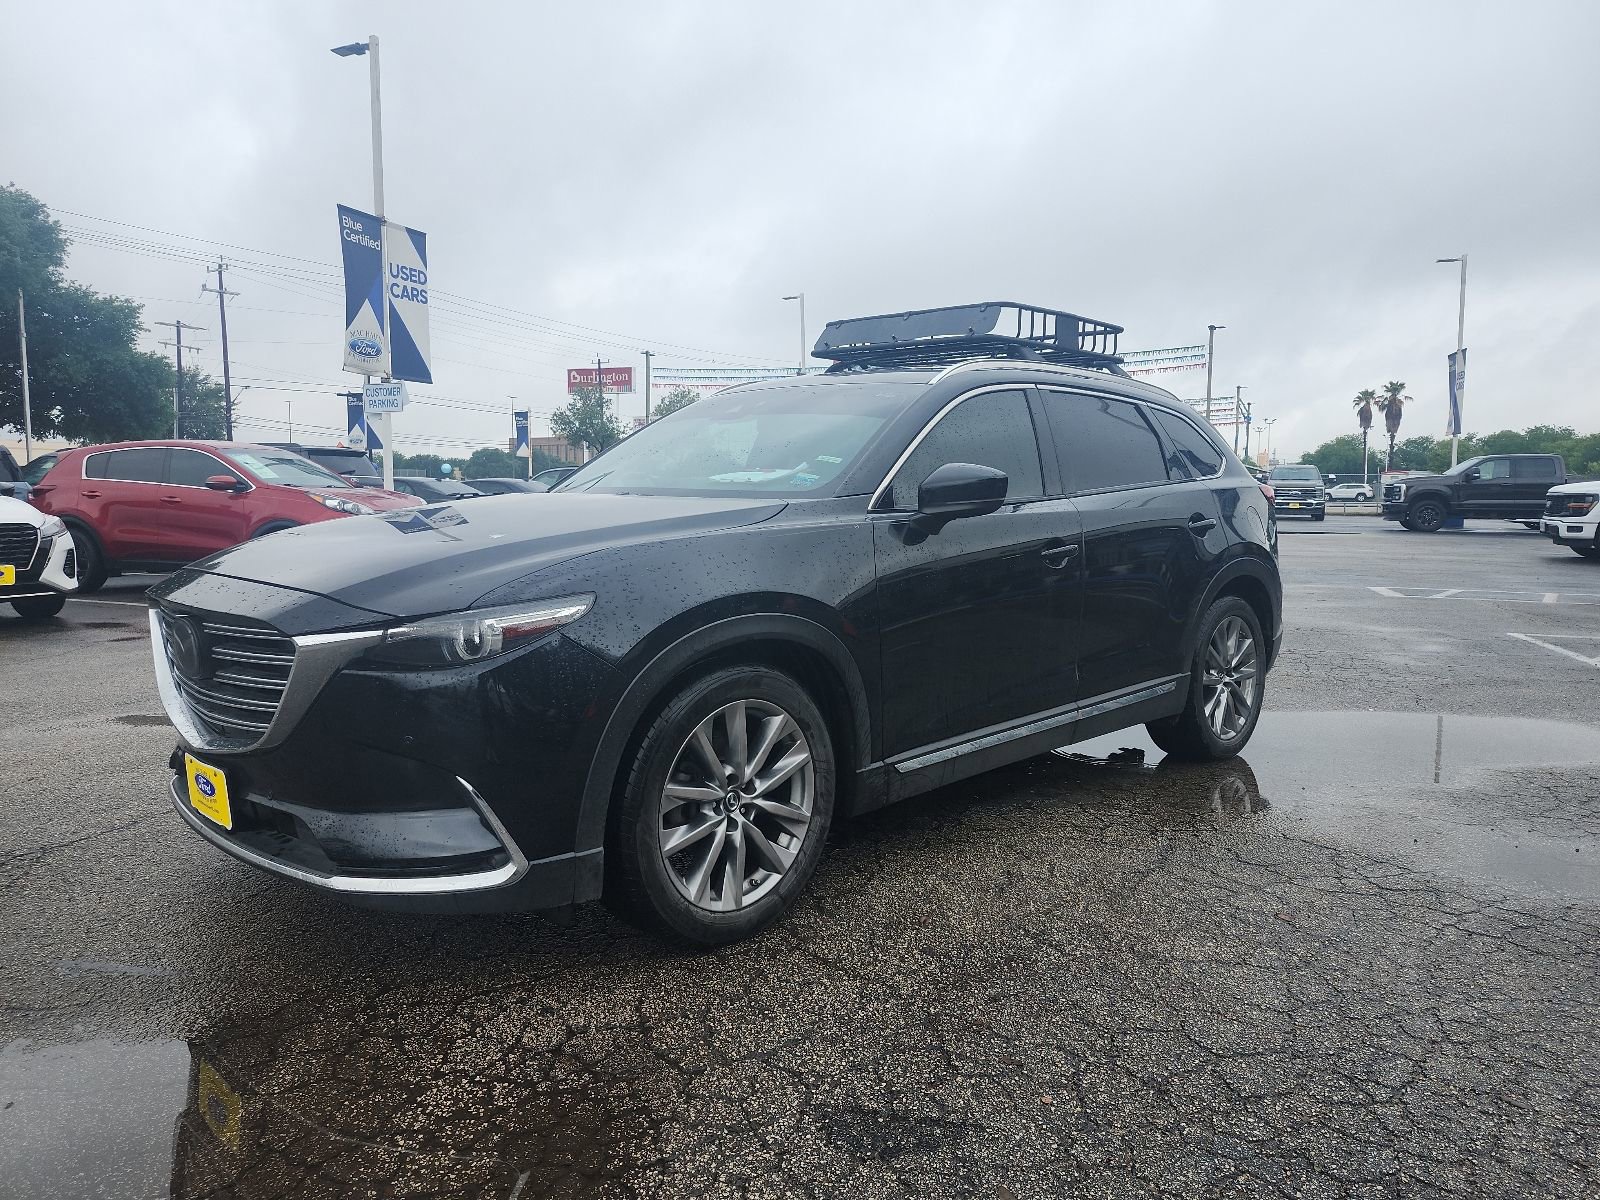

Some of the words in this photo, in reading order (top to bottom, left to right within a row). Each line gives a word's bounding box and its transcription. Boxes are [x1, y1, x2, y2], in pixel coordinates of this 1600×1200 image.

[343, 215, 363, 232] Blue
[343, 229, 381, 251] Certified
[389, 262, 428, 286] USED
[389, 283, 429, 305] CARS
[355, 340, 378, 356] Ford
[570, 370, 629, 385] Burlington
[365, 386, 401, 398] CUSTOMER
[368, 397, 399, 410] PARKING
[198, 775, 212, 795] Ford
